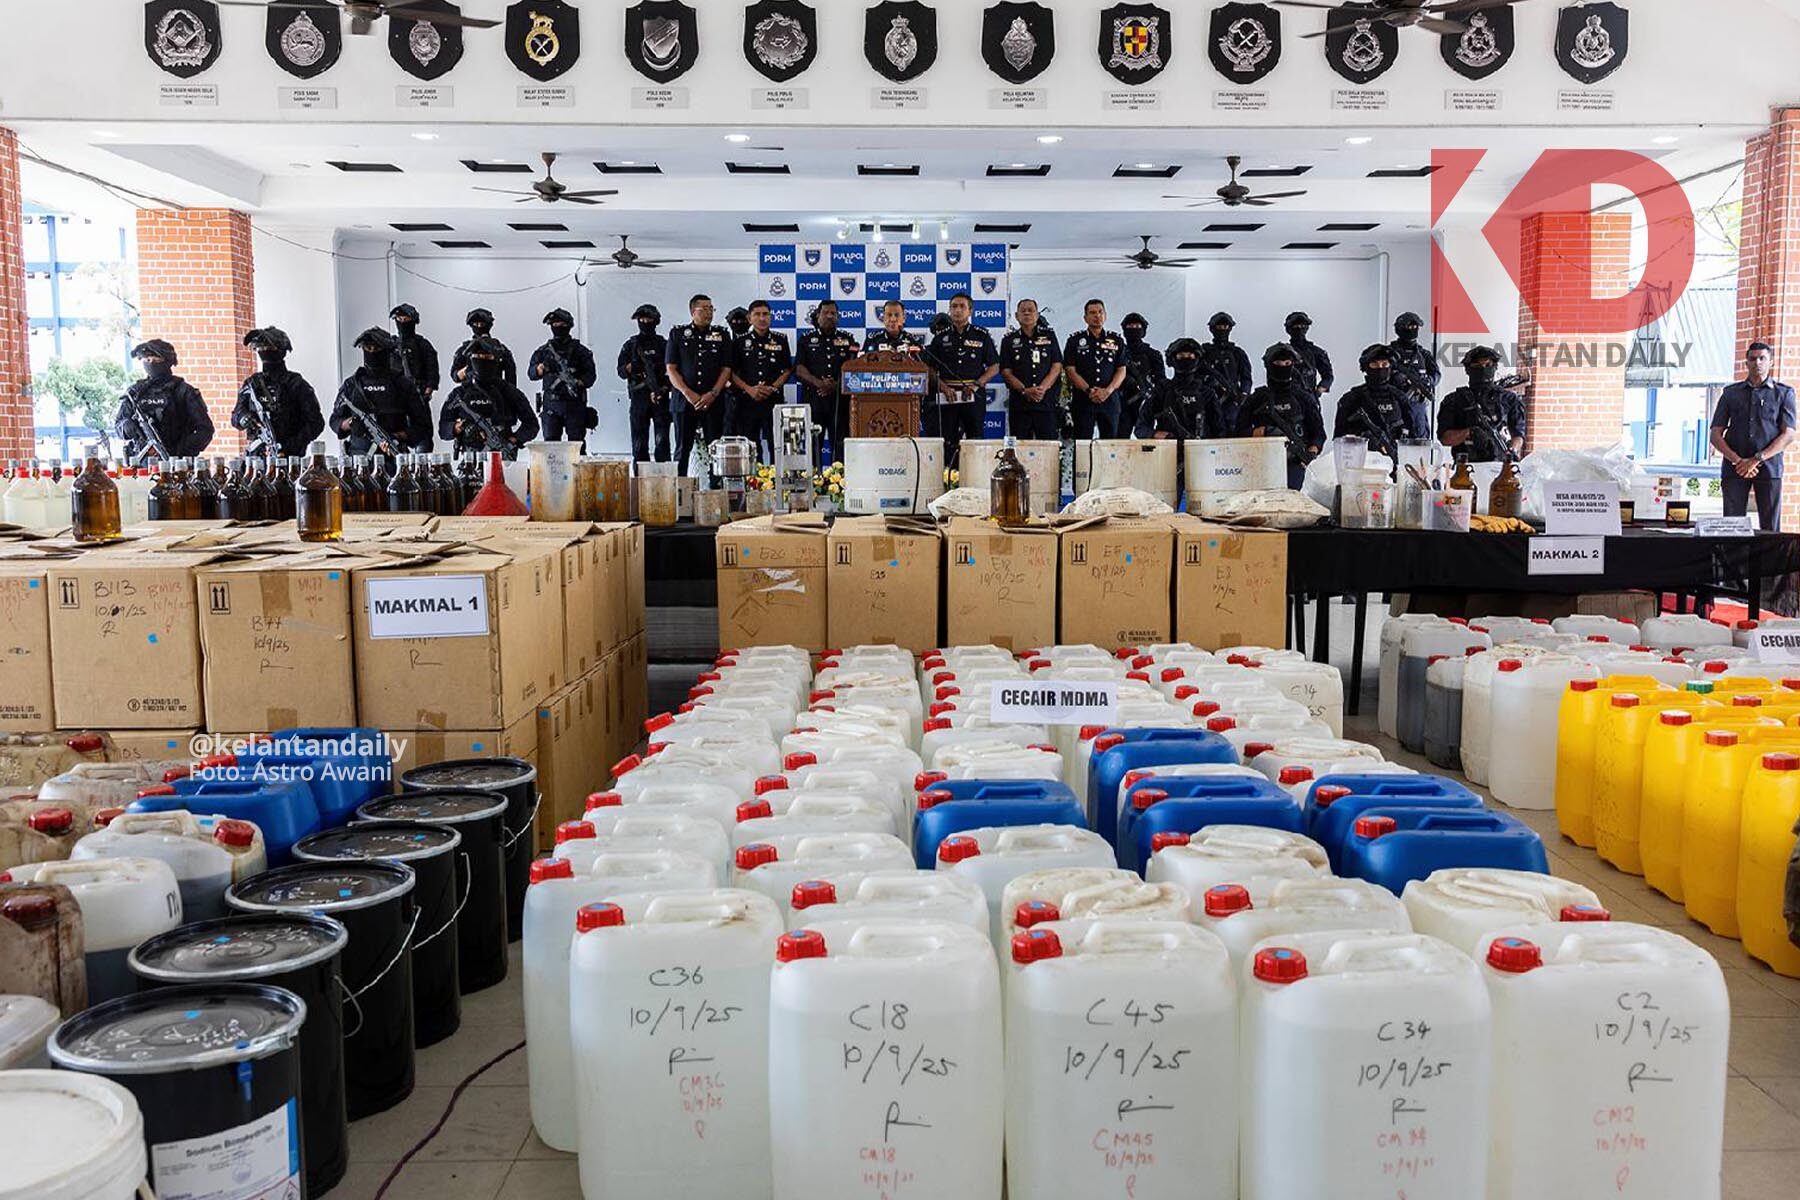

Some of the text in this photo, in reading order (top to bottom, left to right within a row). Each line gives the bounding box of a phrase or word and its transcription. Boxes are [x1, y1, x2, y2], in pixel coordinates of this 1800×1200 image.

[764, 254, 792, 263] PDRM
[905, 254, 933, 263] PDRM
[799, 281, 827, 291] PDRM
[939, 281, 967, 291] PDRM
[1532, 549, 1600, 560] MAKMAL 2
[374, 596, 479, 615] MAKMAL 1
[1001, 689, 1109, 706] CECAIR MDMA
[649, 965, 704, 987] C36
[630, 997, 744, 1037] 10/9/25
